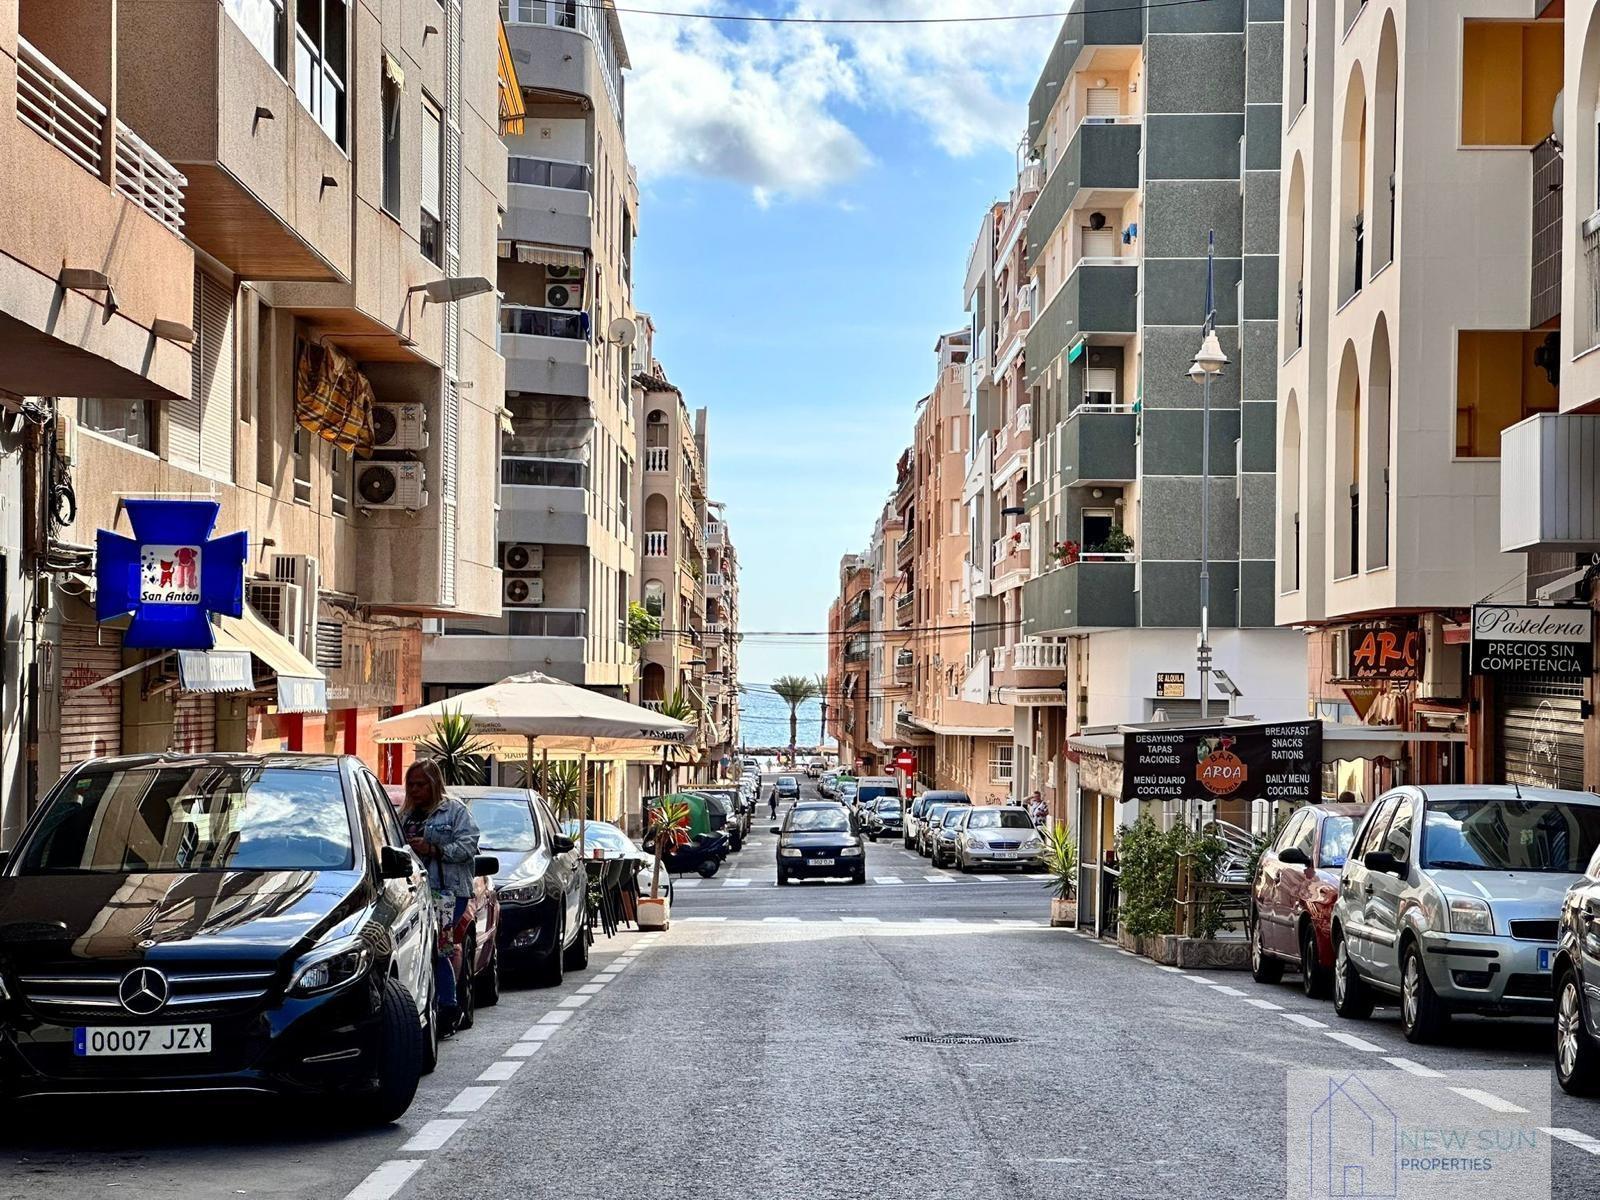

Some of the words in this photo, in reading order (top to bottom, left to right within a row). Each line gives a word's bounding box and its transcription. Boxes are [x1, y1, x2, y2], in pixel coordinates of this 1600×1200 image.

[141, 591, 162, 601] San
[165, 591, 200, 602] Antón
[1488, 643, 1547, 657] PRECIOS
[1551, 644, 1575, 657] SIN
[1480, 657, 1582, 672] COMPETENCIA
[1157, 674, 1164, 683] SE
[1164, 674, 1184, 683] ALQUILA
[649, 729, 686, 742] AMBAR
[1265, 726, 1310, 736] BREAKFAST
[1135, 734, 1185, 744] DESAYUNOS
[1271, 738, 1303, 748] SNACKS
[1148, 745, 1173, 754] TAPAS
[1139, 755, 1181, 764] RACIONES
[1210, 752, 1233, 763] BAR
[1271, 750, 1304, 760] RATIONS
[1203, 765, 1241, 779] AROA
[1158, 775, 1186, 785] DIARIO
[1265, 774, 1288, 784] DAILY
[1289, 774, 1310, 783] MENU
[1137, 785, 1182, 795] COCKTAILS
[1267, 785, 1309, 795] COCKTAILS
[92, 1030, 151, 1052] 0007
[161, 1027, 206, 1050] JZX
